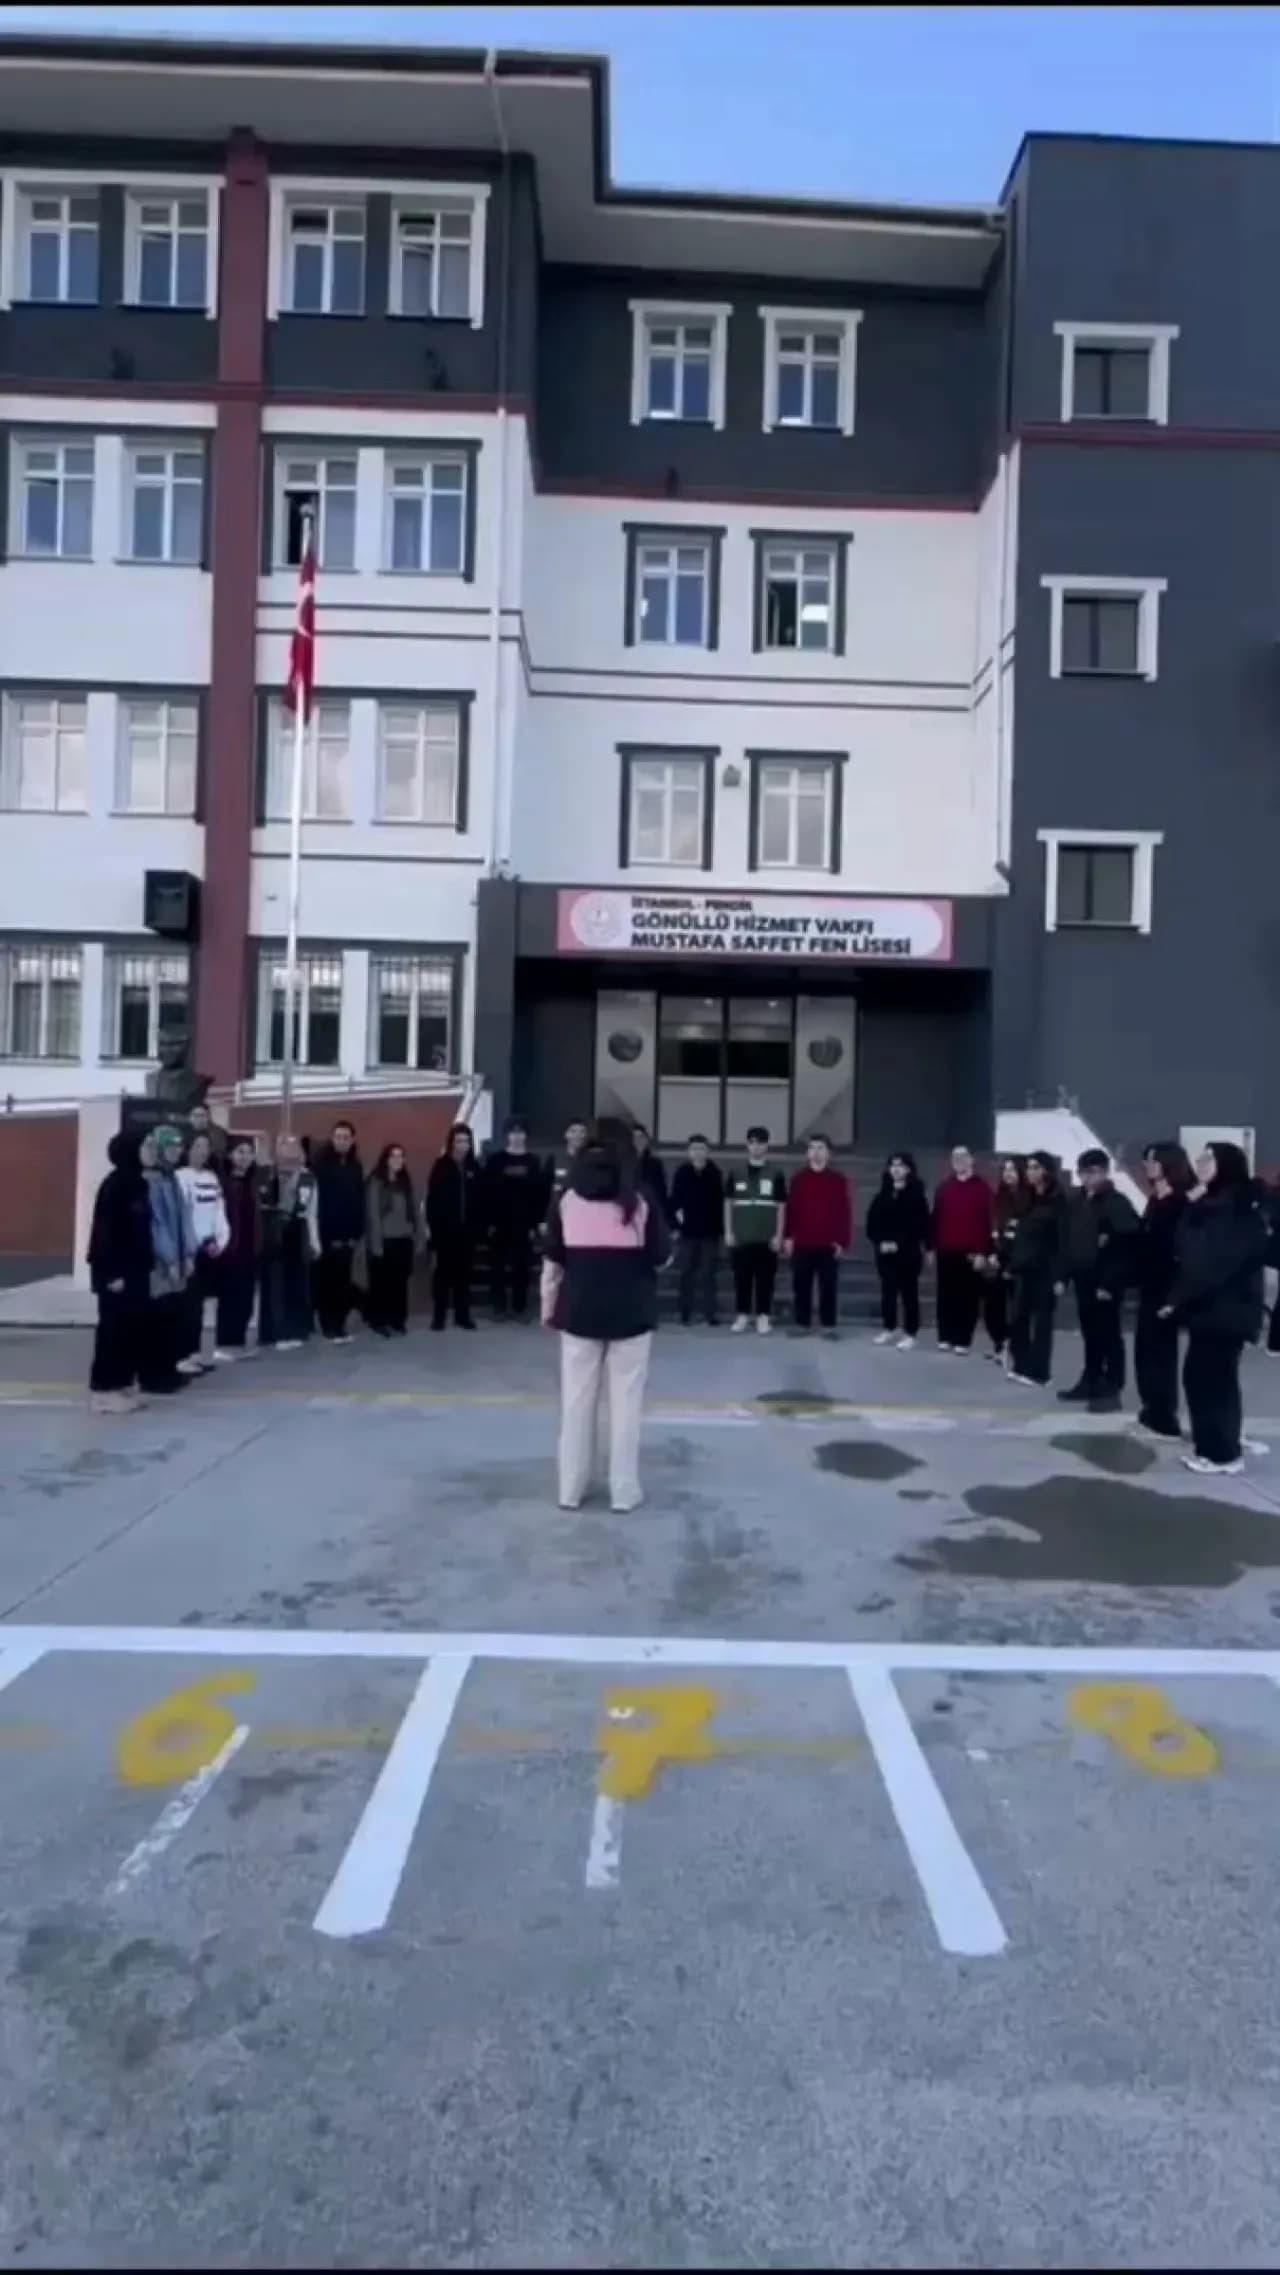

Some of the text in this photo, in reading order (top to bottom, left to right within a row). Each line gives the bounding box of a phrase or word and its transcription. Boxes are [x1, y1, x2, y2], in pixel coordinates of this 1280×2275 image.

[631, 932, 911, 955] MUSTAFA SAFFET FEN LİSESİ
[632, 911, 874, 935] GÖNÜLLÜ HİZMET VAKFI
[116, 1673, 256, 1787] 6
[598, 1684, 718, 1800] 7
[1067, 1683, 1221, 1778] 8
